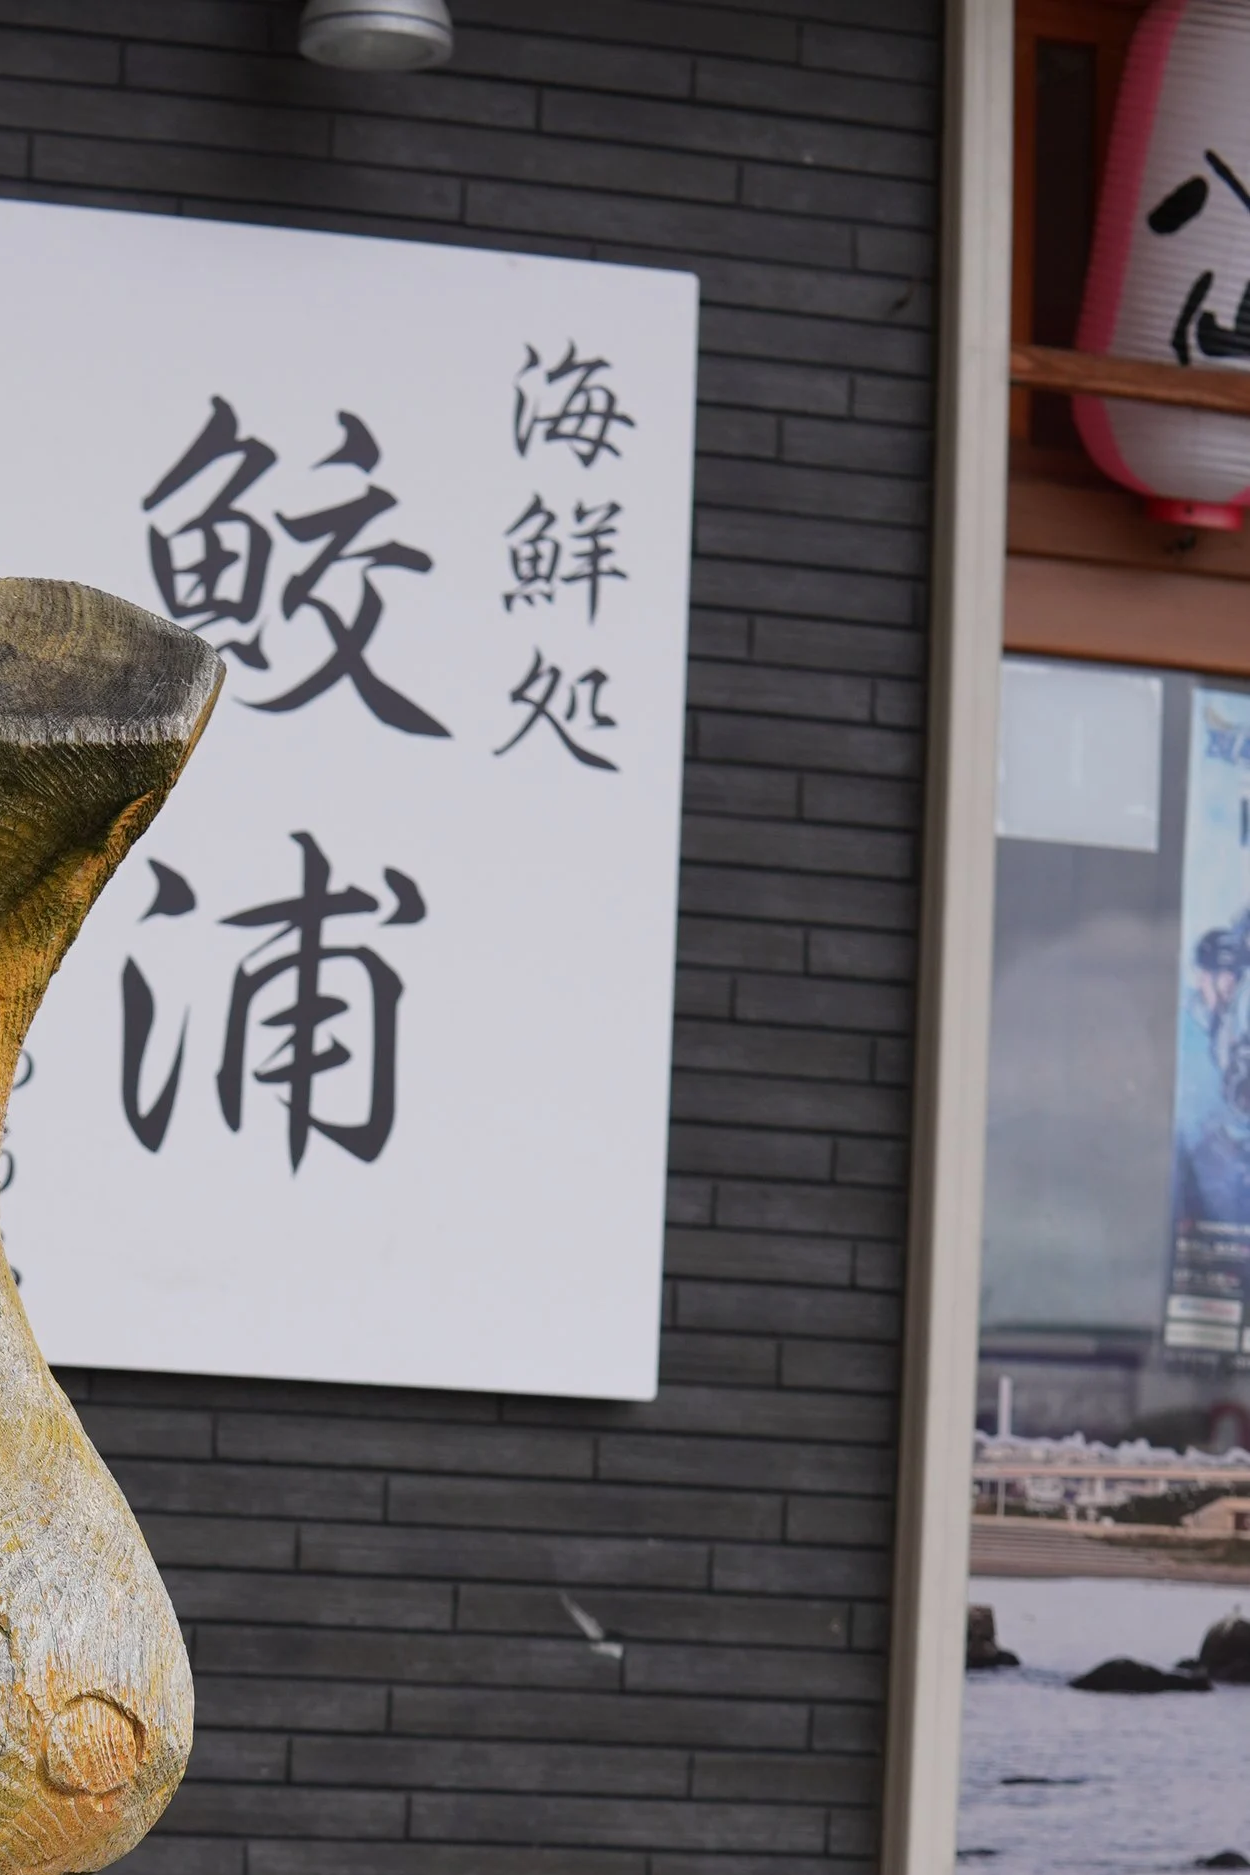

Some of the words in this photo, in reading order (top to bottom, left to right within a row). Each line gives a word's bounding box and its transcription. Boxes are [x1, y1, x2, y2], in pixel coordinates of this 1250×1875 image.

[120, 394, 453, 1175] 鮫浦
[492, 340, 637, 773] 海鮮処
